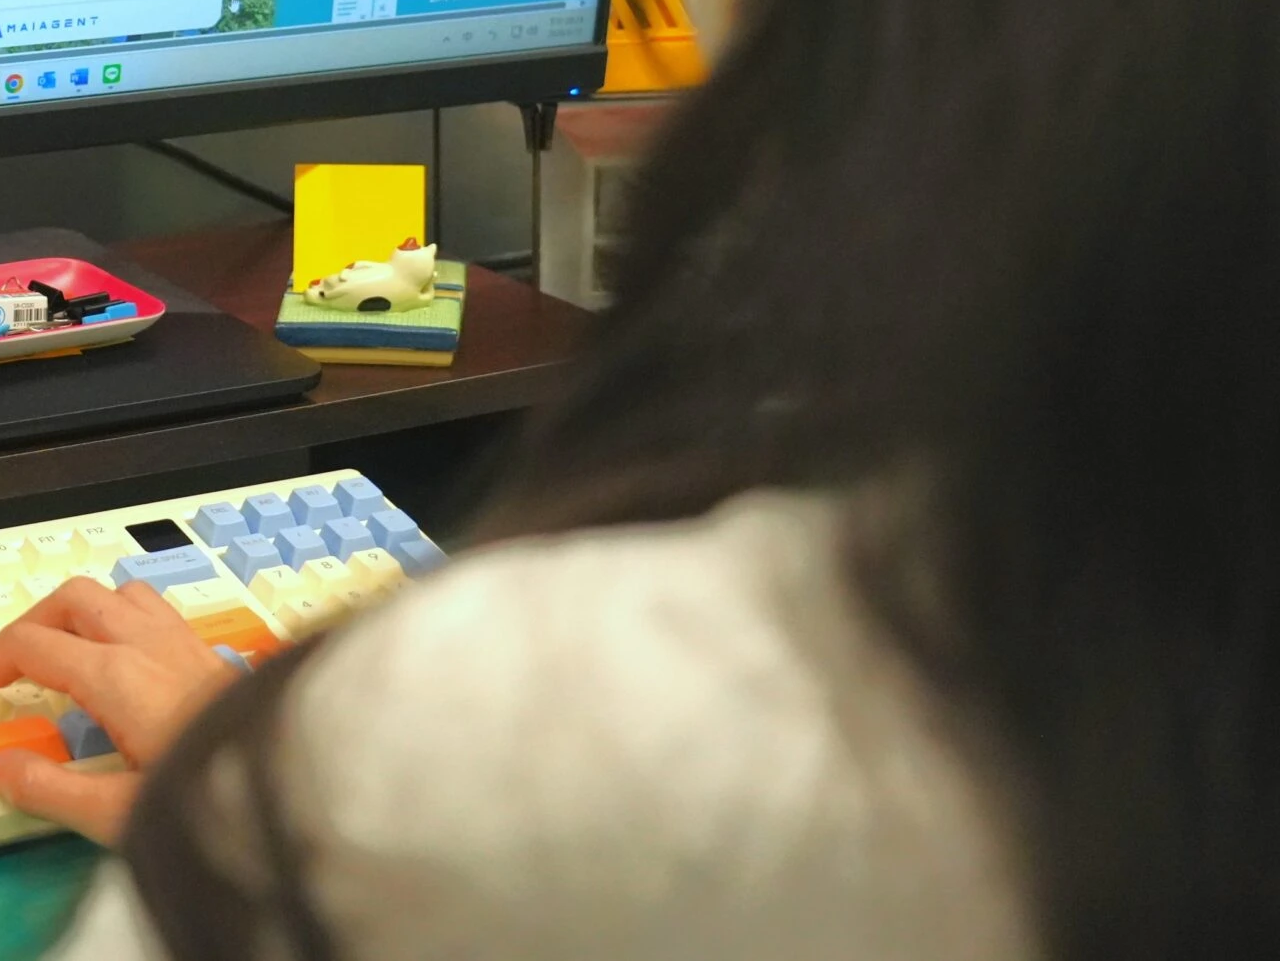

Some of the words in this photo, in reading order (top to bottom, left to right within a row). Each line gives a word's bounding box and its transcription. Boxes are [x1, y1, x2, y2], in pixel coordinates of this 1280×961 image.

[6, 16, 99, 33] MAIAGENT
[86, 526, 105, 536] F12
[38, 535, 56, 544] F11
[367, 552, 379, 562] 9
[321, 561, 333, 570] 8
[273, 569, 283, 579] 7
[302, 600, 313, 610] 4
